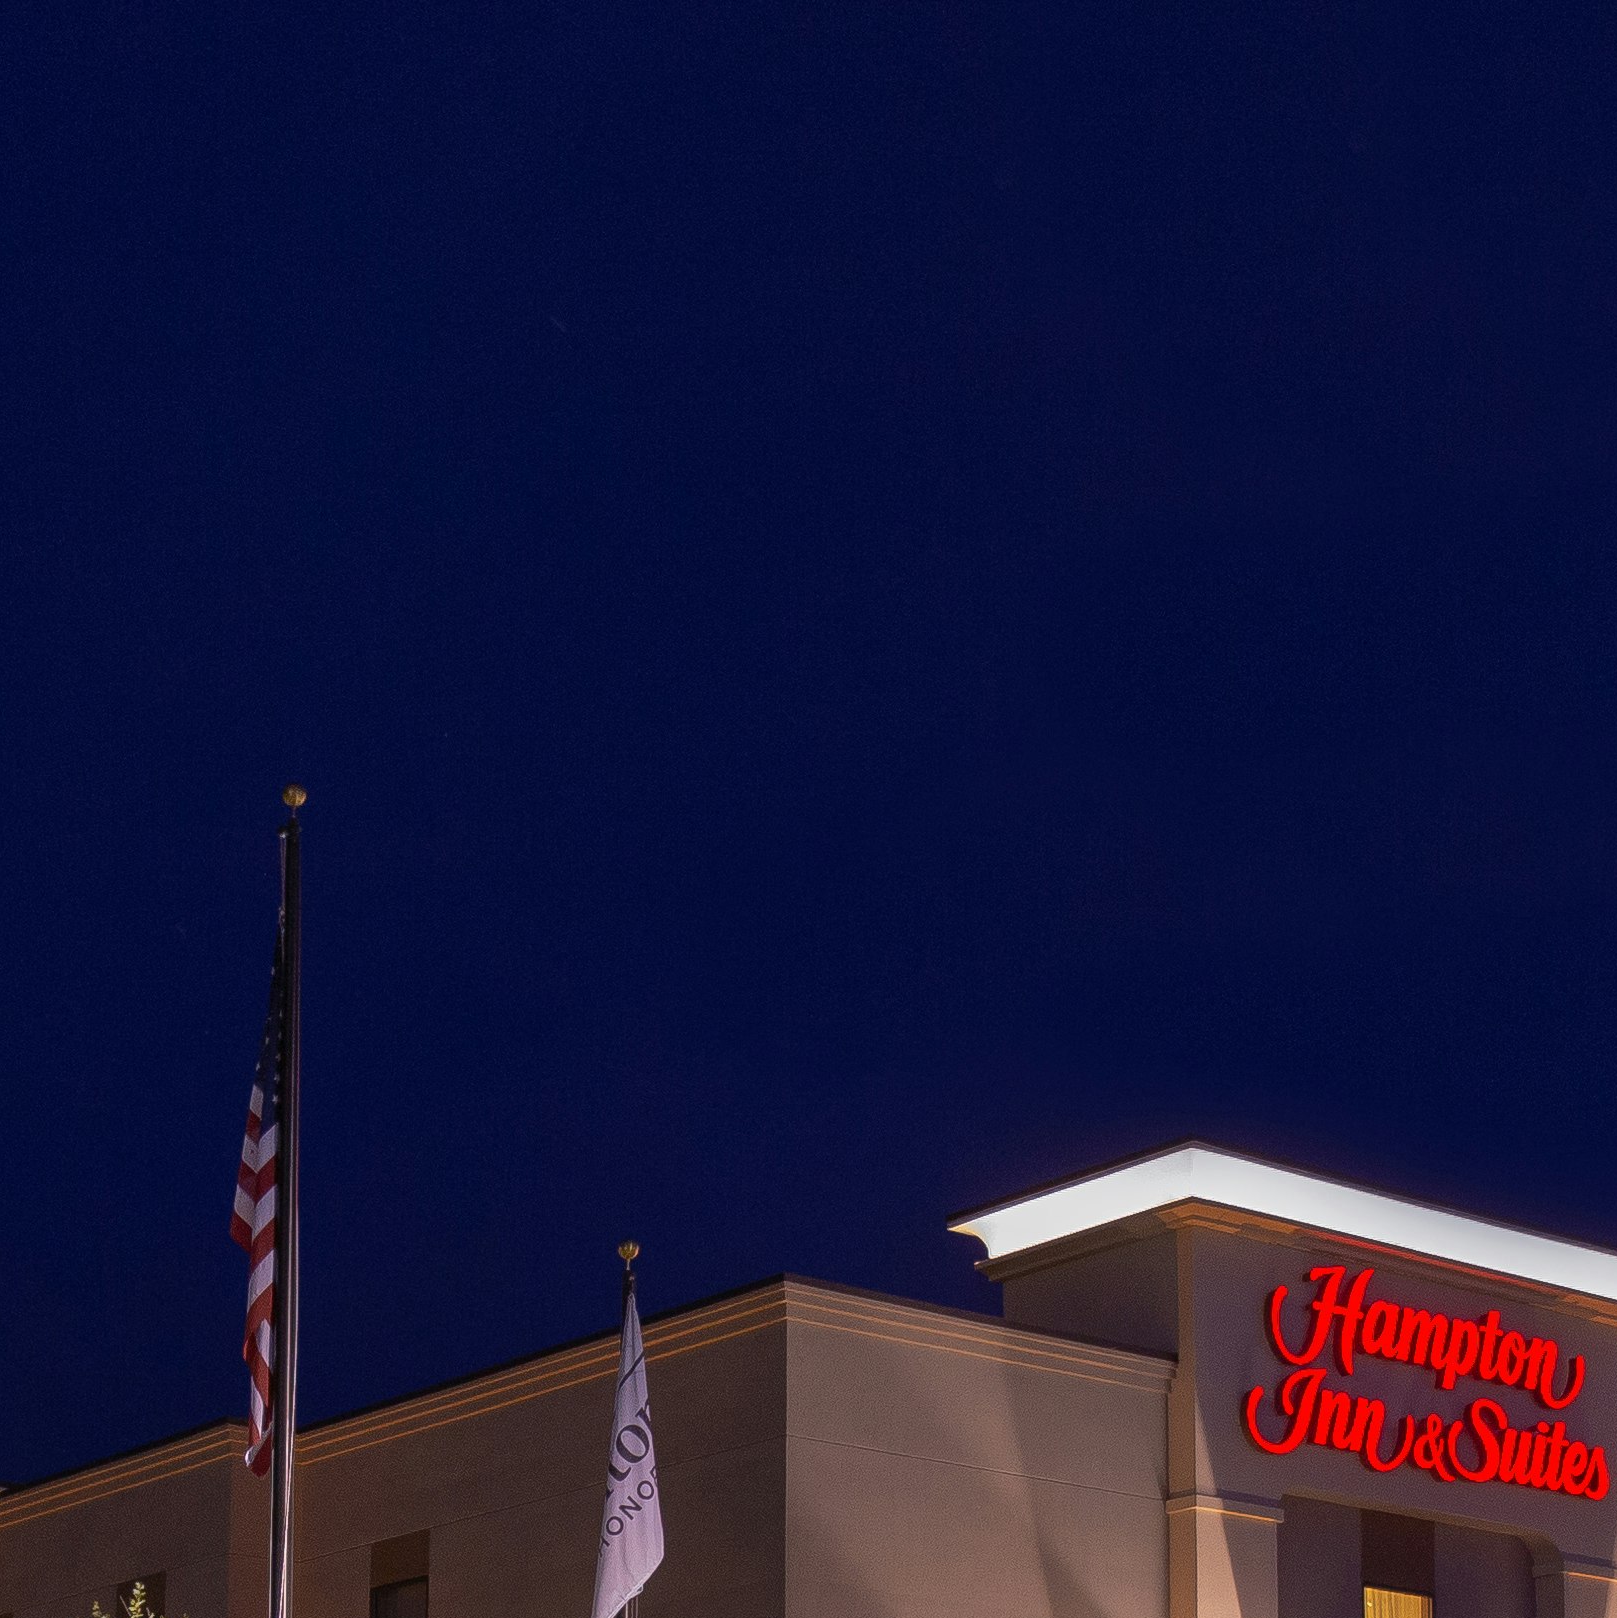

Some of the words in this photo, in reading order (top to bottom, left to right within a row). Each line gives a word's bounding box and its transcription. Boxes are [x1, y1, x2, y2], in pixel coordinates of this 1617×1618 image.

[1271, 1265, 1585, 1410] Hampton
[1246, 1368, 1413, 1472] Inn
[1448, 1398, 1611, 1501] Suites
